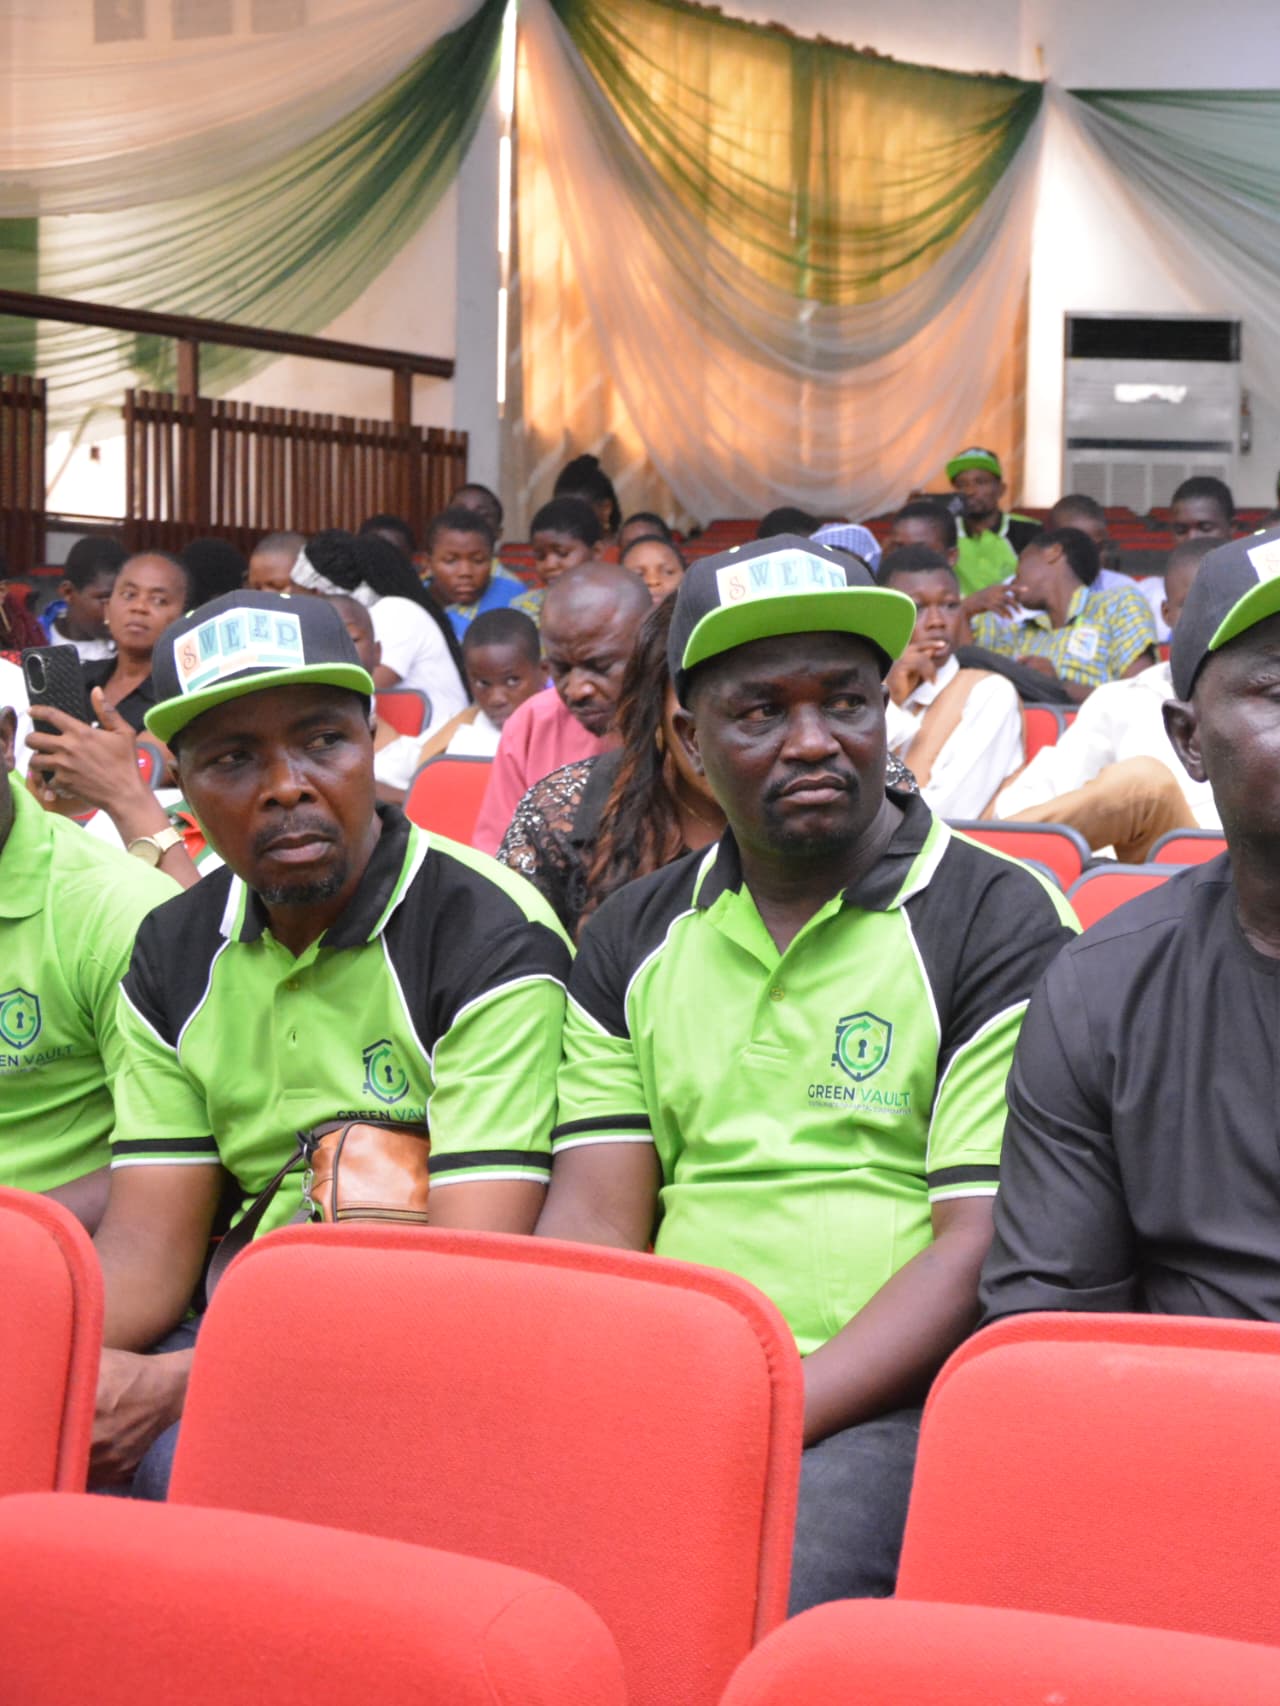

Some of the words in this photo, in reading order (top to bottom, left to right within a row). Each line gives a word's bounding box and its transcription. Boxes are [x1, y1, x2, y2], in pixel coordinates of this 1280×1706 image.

[807, 1083, 855, 1101] GREEN
[861, 1087, 911, 1107] VAULT
[336, 1109, 391, 1121] GREEN
